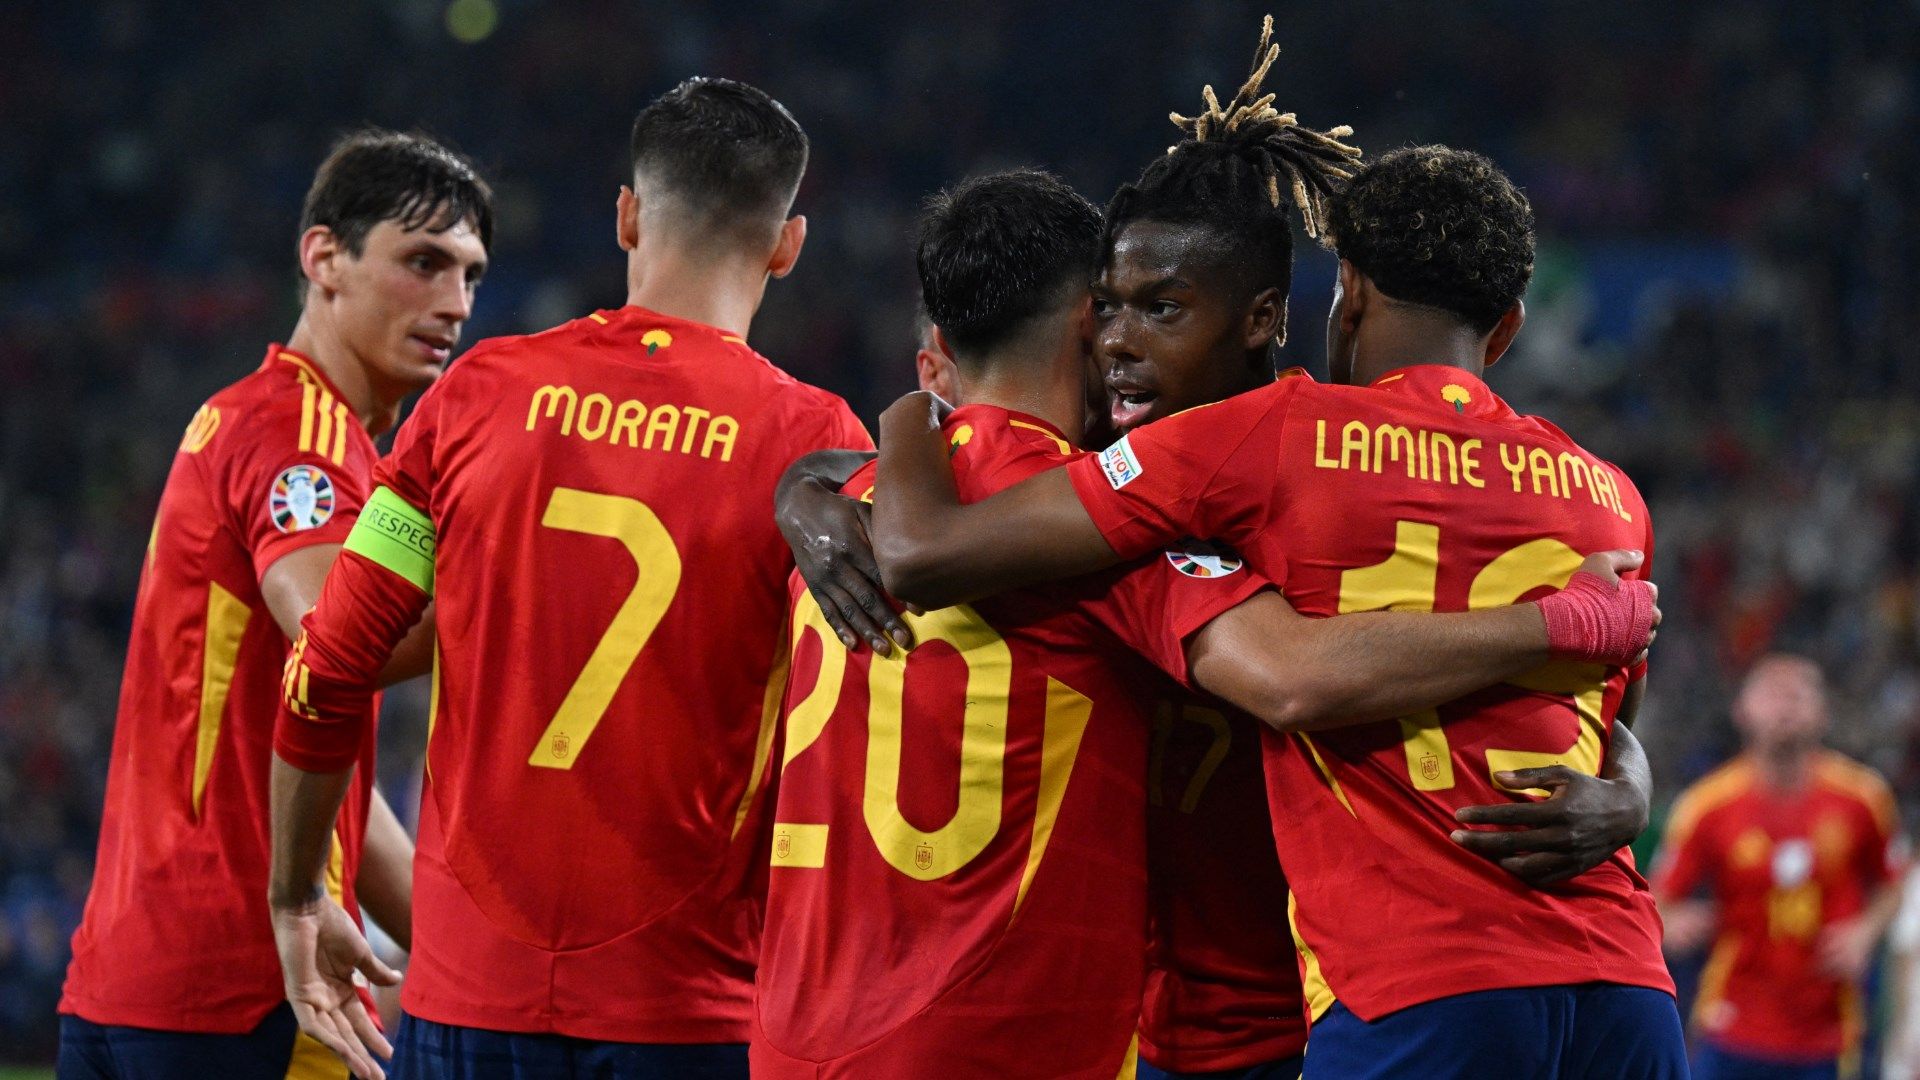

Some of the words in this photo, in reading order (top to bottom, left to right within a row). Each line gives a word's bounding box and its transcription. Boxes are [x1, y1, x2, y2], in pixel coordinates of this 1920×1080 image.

[526, 385, 739, 461] MORATA
[1110, 447, 1133, 482] ATION
[1315, 420, 1485, 488] LAMINE
[1500, 443, 1632, 523] YAMAL
[528, 486, 682, 770] 7
[769, 586, 1013, 882] 20
[1150, 700, 1233, 814] 17
